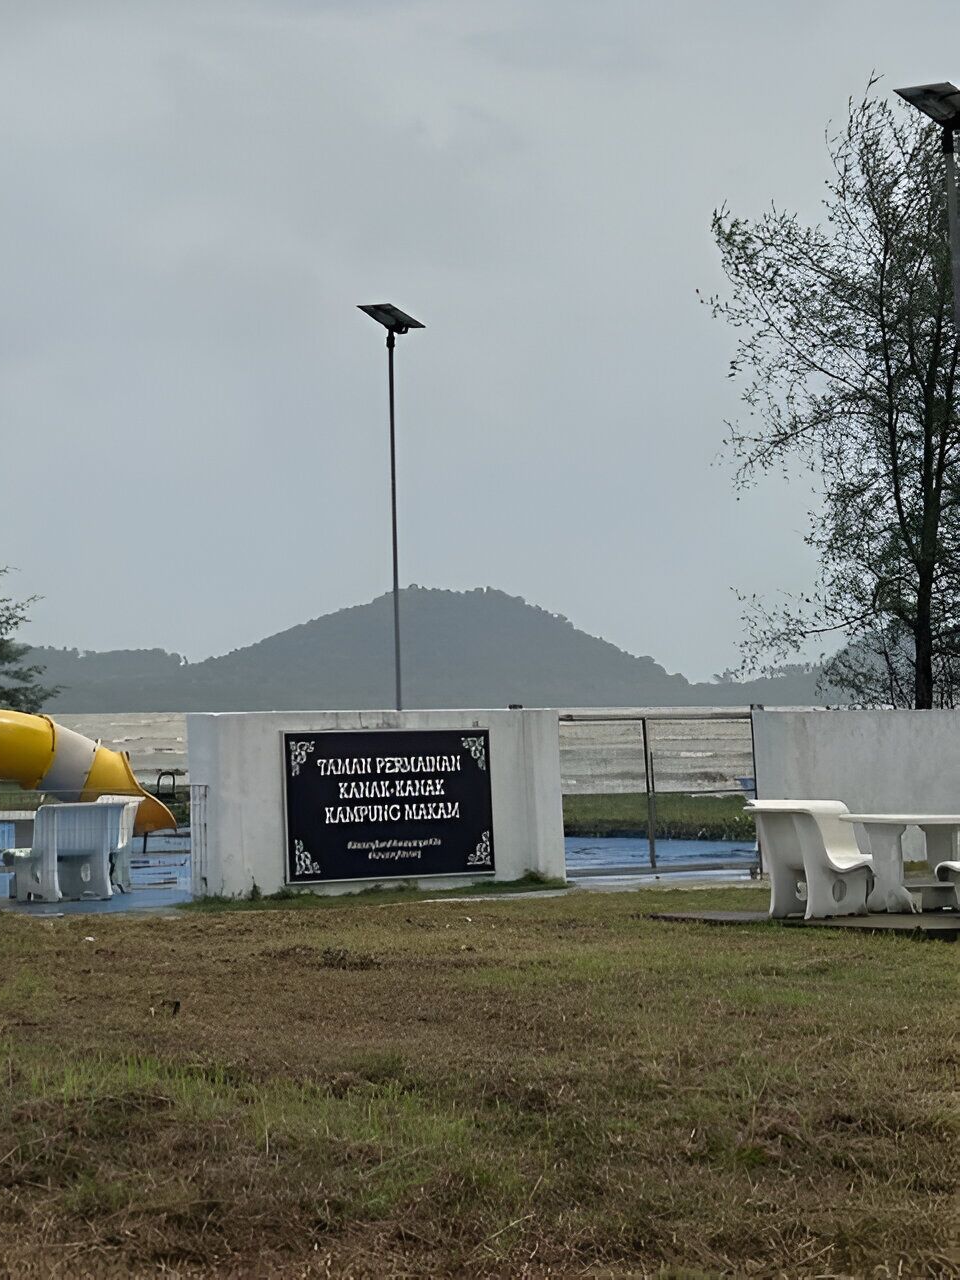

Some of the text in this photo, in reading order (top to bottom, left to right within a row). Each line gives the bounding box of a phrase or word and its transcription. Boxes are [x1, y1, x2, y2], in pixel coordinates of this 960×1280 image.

[316, 755, 461, 776] TAMAN PERMAINAN
[338, 779, 445, 799] KANAK-KANAK
[324, 802, 460, 824] KAMPUNG MAKAM
